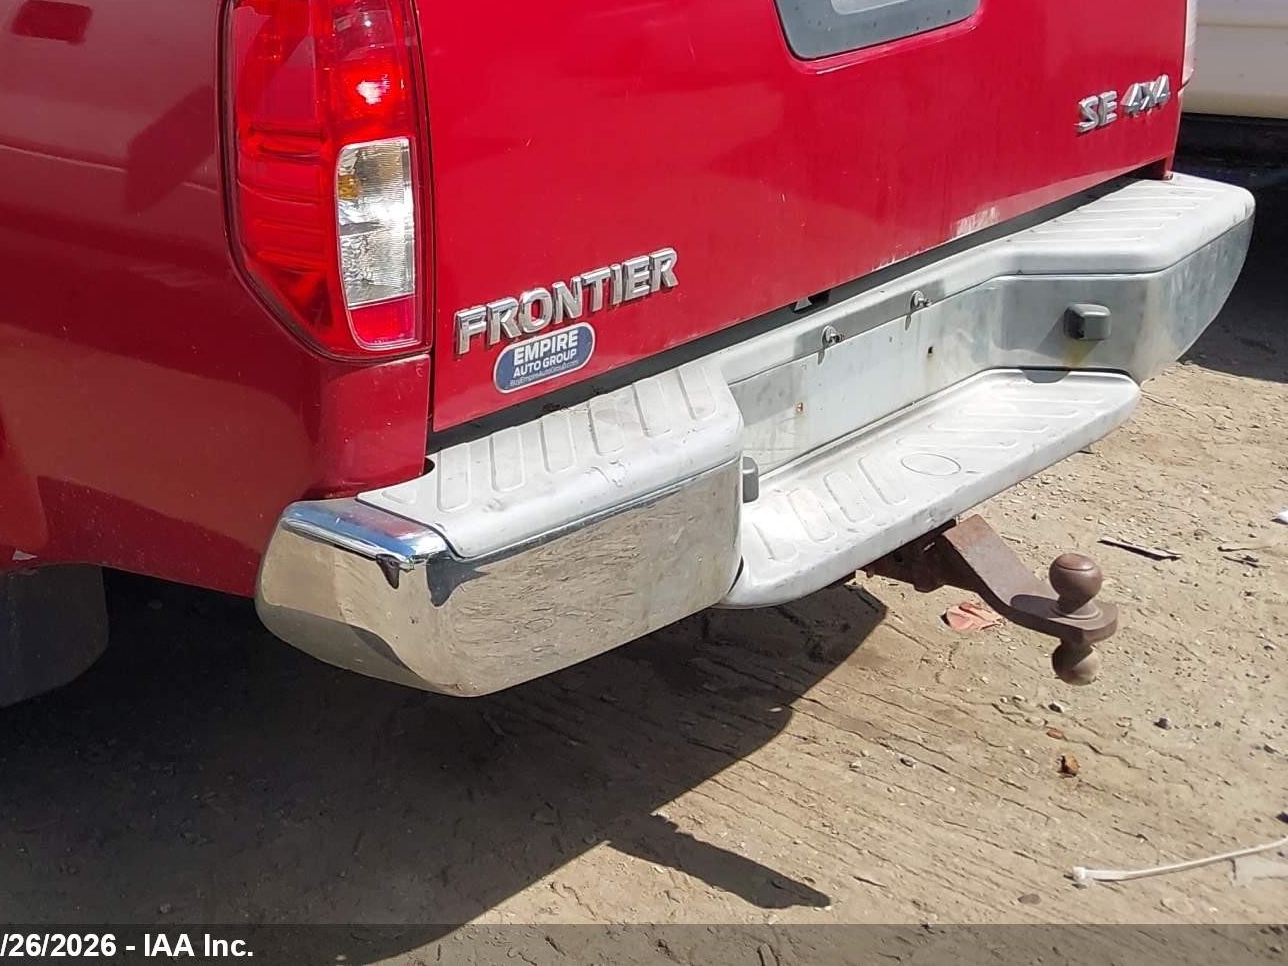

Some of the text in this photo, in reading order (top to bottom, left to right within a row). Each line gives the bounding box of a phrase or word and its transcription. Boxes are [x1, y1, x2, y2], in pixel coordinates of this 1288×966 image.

[1074, 90, 1118, 133] SE
[454, 247, 679, 355] FRONTIER
[513, 329, 579, 366] EMPIRE
[513, 348, 578, 379] AUTO GROUP
